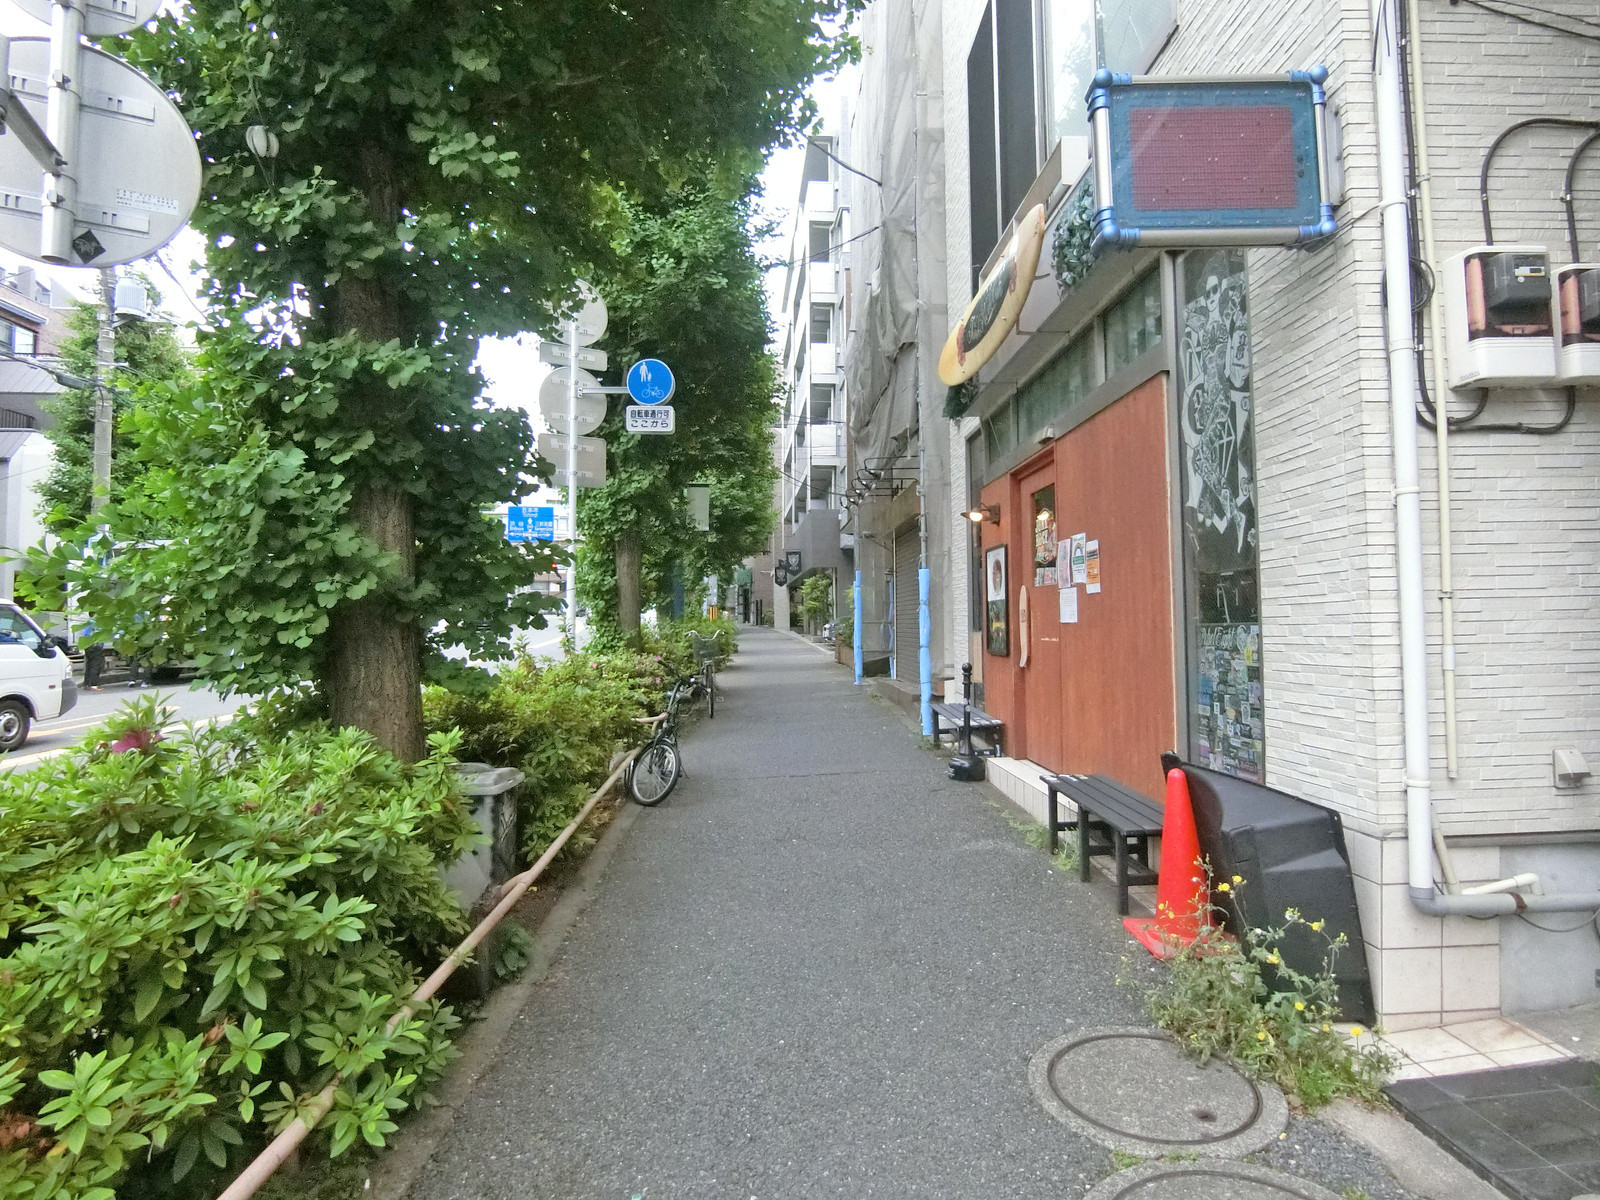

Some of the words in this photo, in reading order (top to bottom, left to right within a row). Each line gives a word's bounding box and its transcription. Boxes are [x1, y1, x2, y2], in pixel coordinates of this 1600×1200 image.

[630, 409, 670, 419] 自転車通行可
[630, 419, 669, 428] ここから
